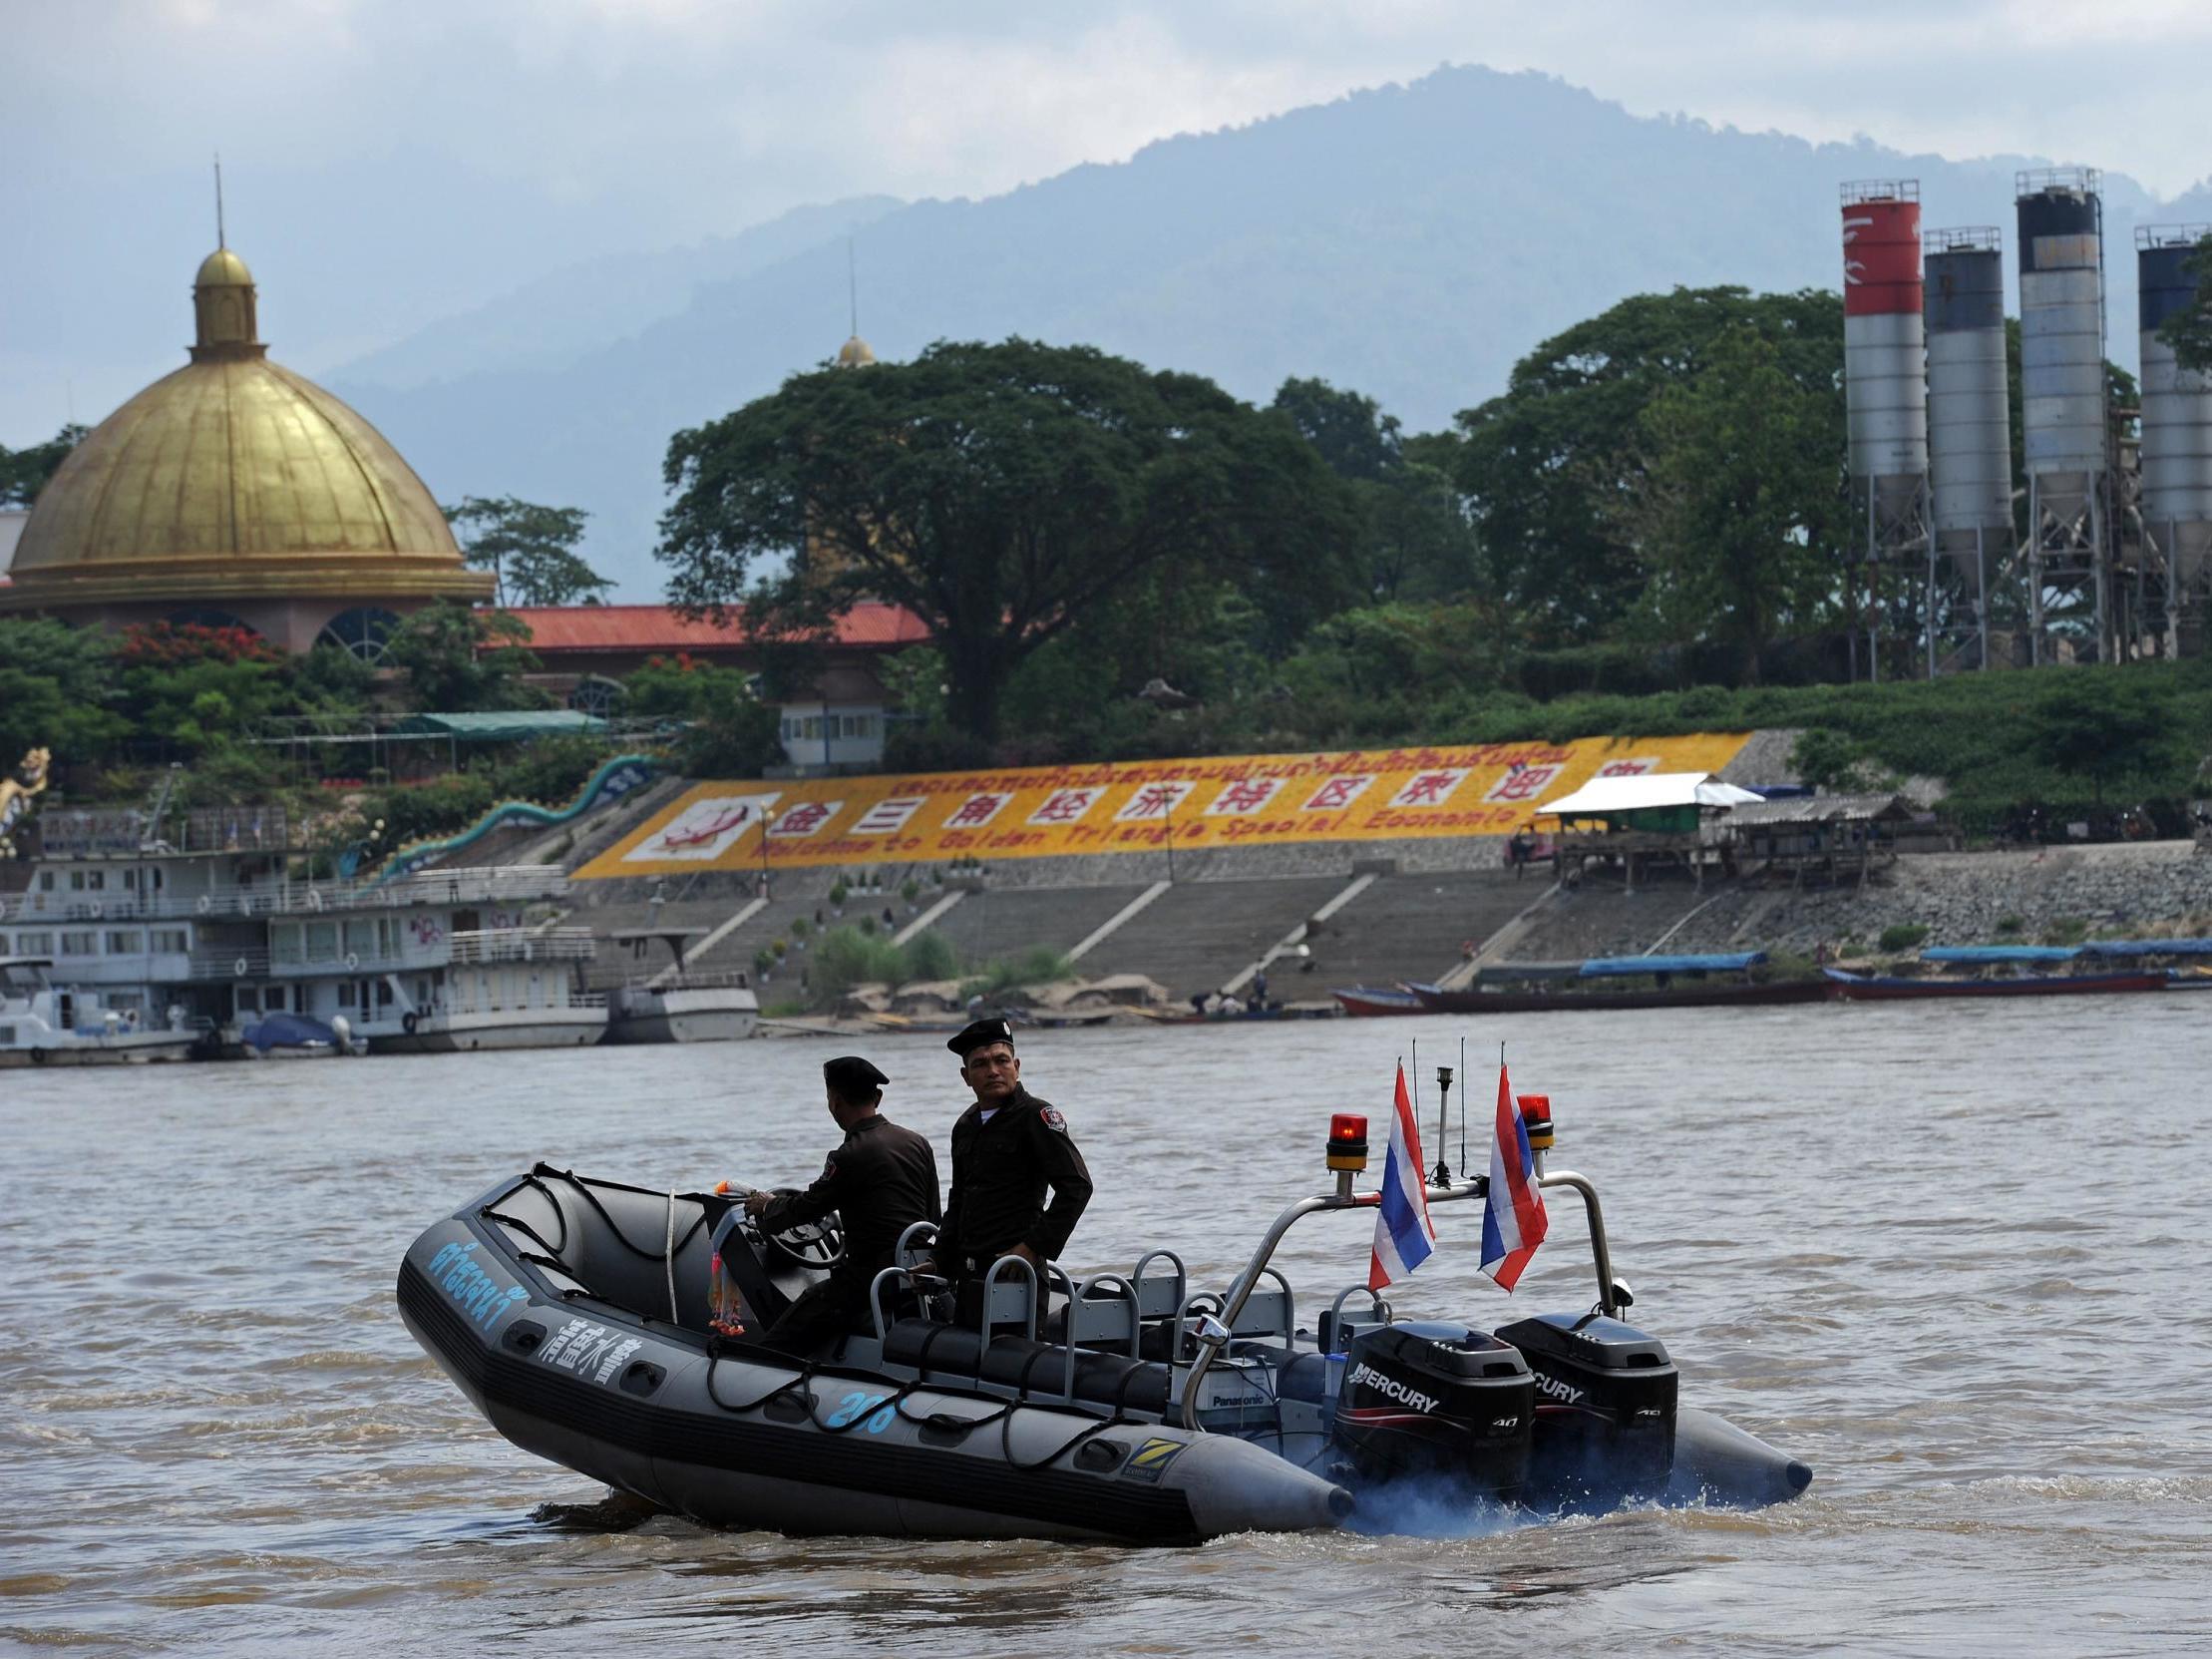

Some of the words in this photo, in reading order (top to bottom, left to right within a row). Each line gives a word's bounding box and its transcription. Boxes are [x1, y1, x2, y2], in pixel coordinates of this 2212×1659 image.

[750, 839, 875, 858] Welcome
[886, 835, 922, 850] to
[937, 830, 1046, 849] Golden
[1066, 820, 1206, 844] Triangle
[1220, 812, 1349, 838] Special
[1363, 808, 1516, 829] Economic
[429, 1243, 530, 1331] ตำรวจน้ำ
[539, 1319, 642, 1385] 清盛水警
[1214, 1394, 1265, 1407] Panasonic
[1351, 1362, 1440, 1414] MERCURY
[1533, 1372, 1584, 1405] CURY
